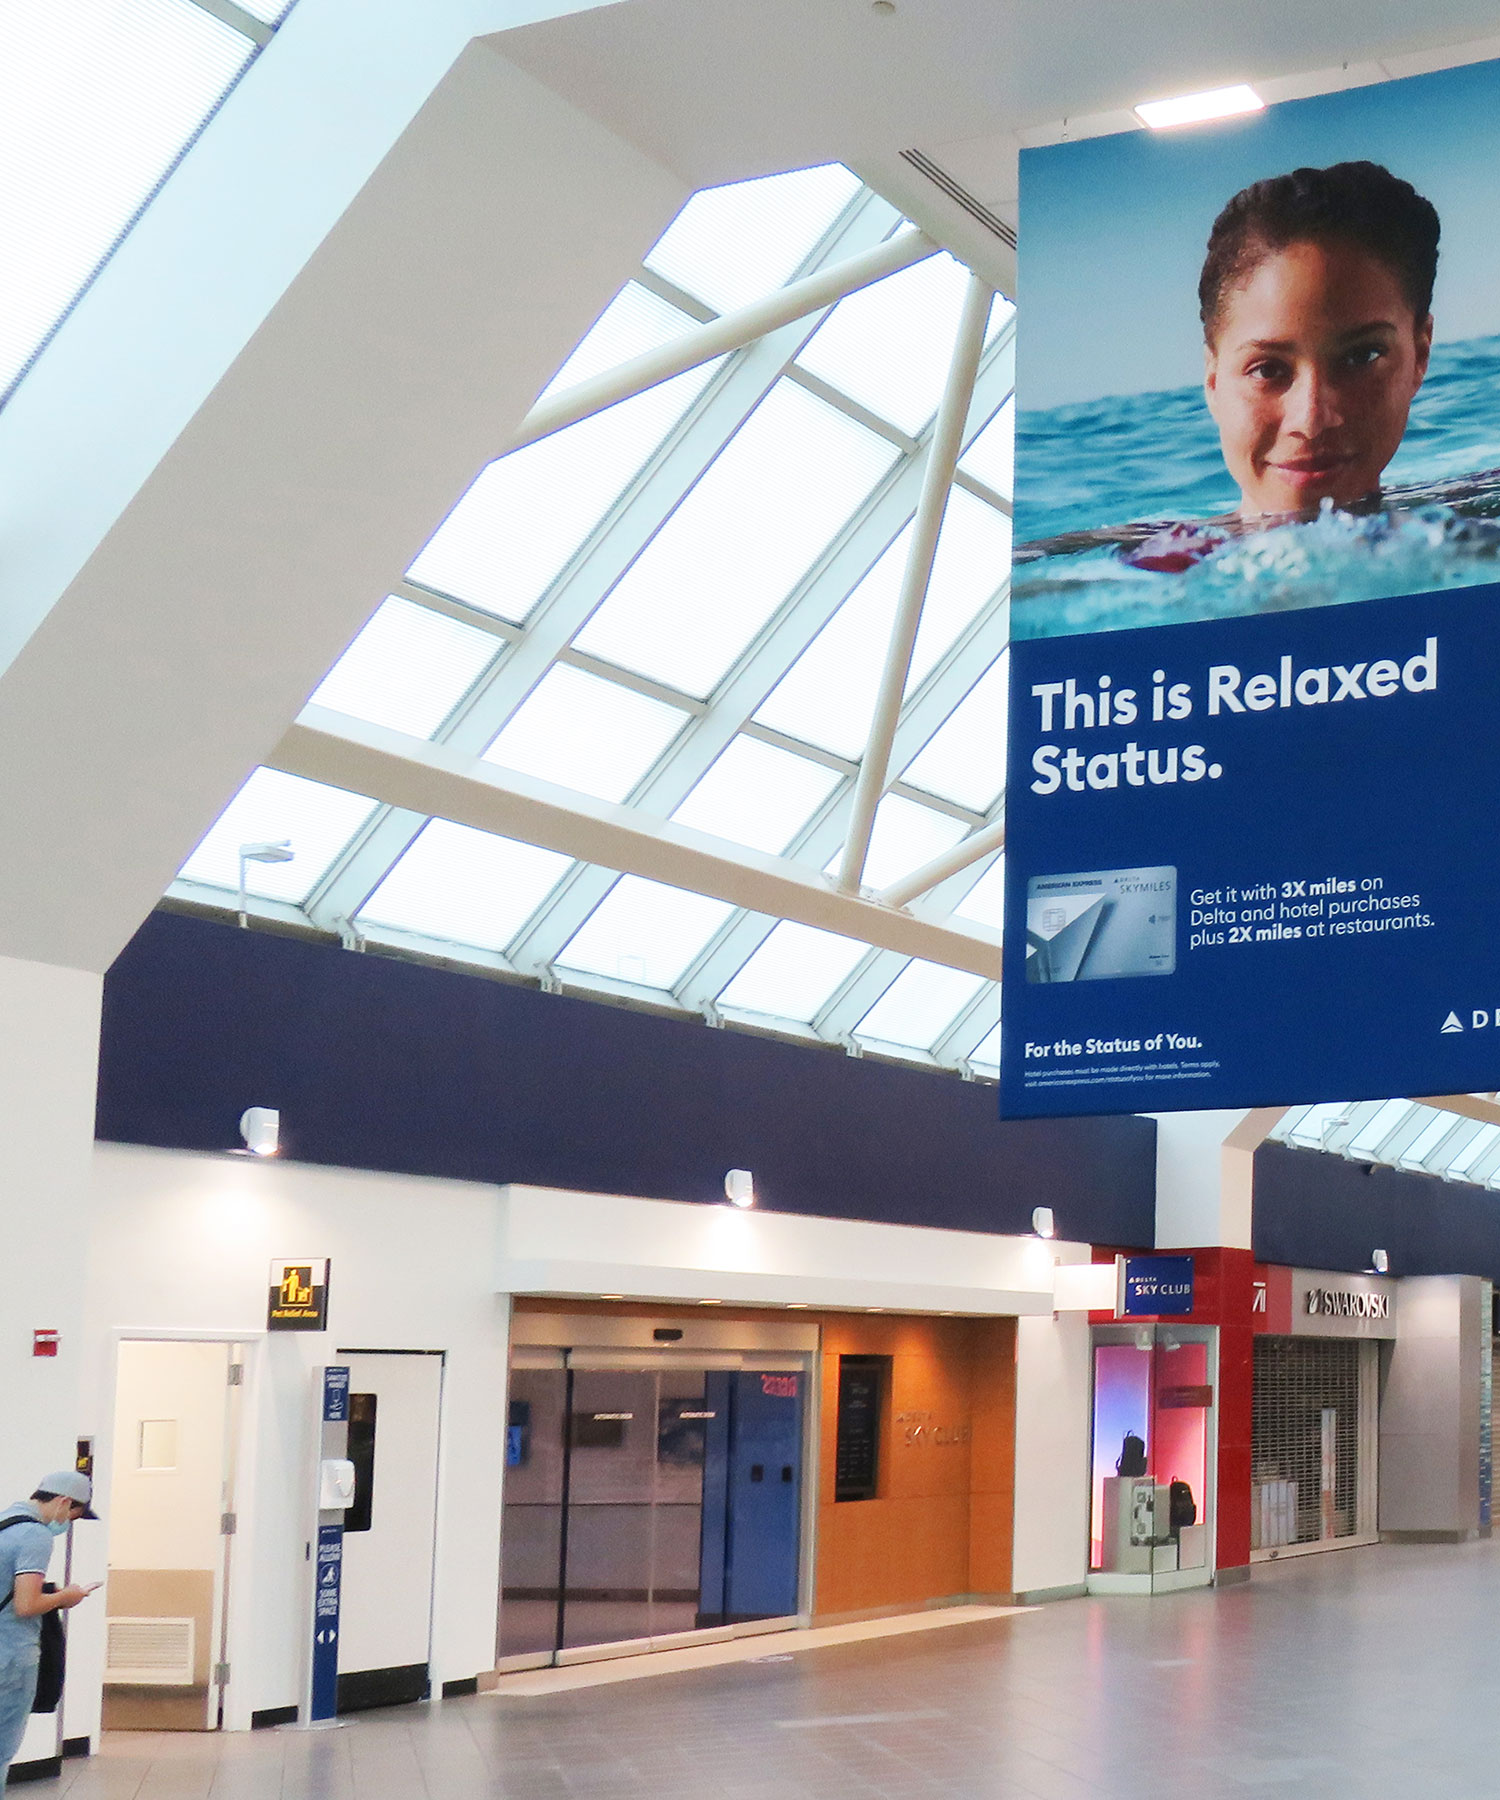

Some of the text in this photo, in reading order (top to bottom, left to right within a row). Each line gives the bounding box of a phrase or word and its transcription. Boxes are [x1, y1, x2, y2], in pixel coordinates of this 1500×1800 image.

[1032, 636, 1438, 732] This is Relaxed
[1030, 742, 1223, 795] Status.
[1120, 881, 1171, 894] SKYMILES
[1190, 877, 1384, 906] Get it with 3X miles on
[1190, 908, 1236, 926] Delta
[1241, 903, 1275, 922] and
[1280, 899, 1324, 919] hotel
[1328, 893, 1420, 918] purchases
[1190, 912, 1435, 950] plus 2X miles at restaurants.
[1025, 1033, 1202, 1058] For the Status of You.
[1135, 1284, 1191, 1296] SKY CLUB
[1324, 1290, 1390, 1318] SWAROVSKI
[271, 1310, 283, 1318] Pet
[302, 1309, 319, 1318] Area
